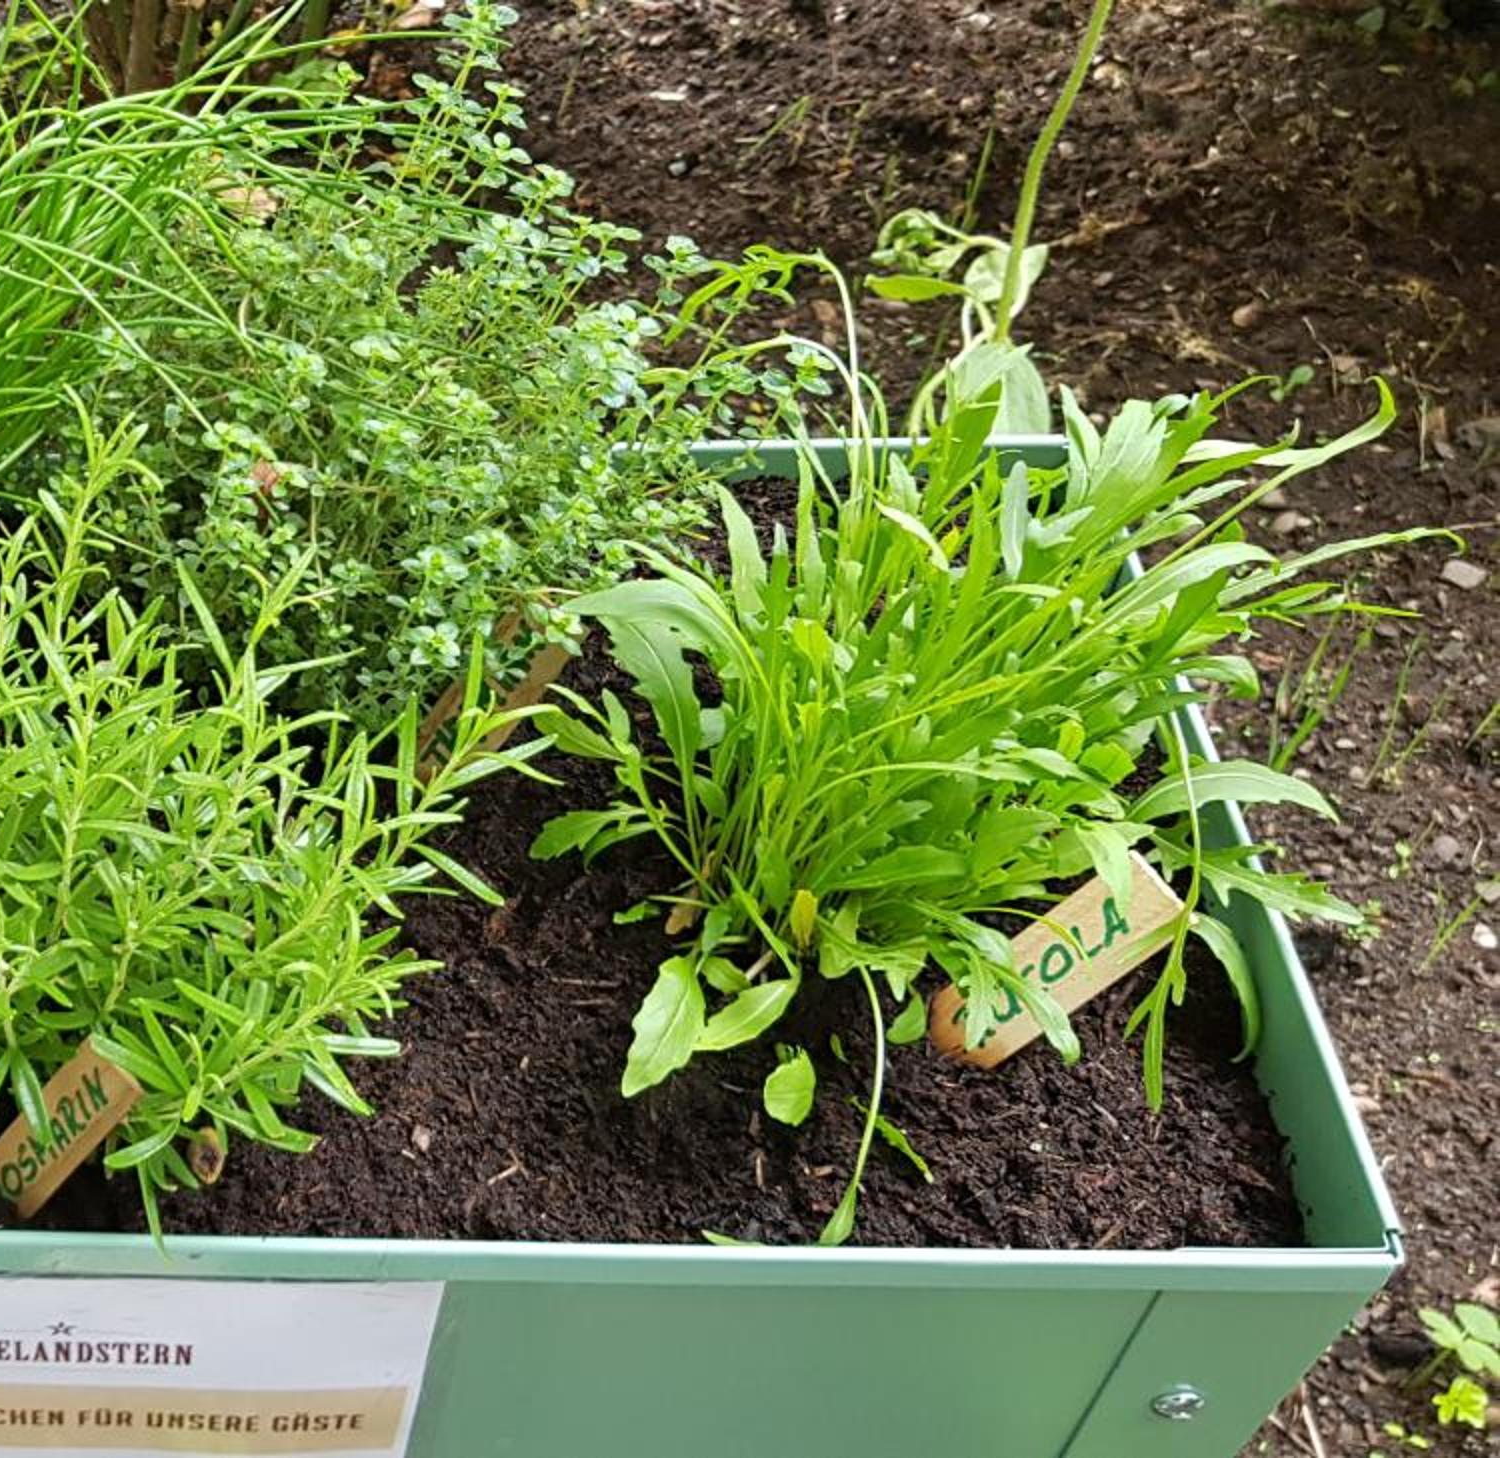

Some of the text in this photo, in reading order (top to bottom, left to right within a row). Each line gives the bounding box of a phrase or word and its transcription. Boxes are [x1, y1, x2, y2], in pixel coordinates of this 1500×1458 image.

[952, 896, 1130, 1048] UOLA
[77, 1407, 133, 1427] FÜR
[146, 1411, 260, 1433] UNSERE
[271, 1410, 365, 1434] GÄSTE
